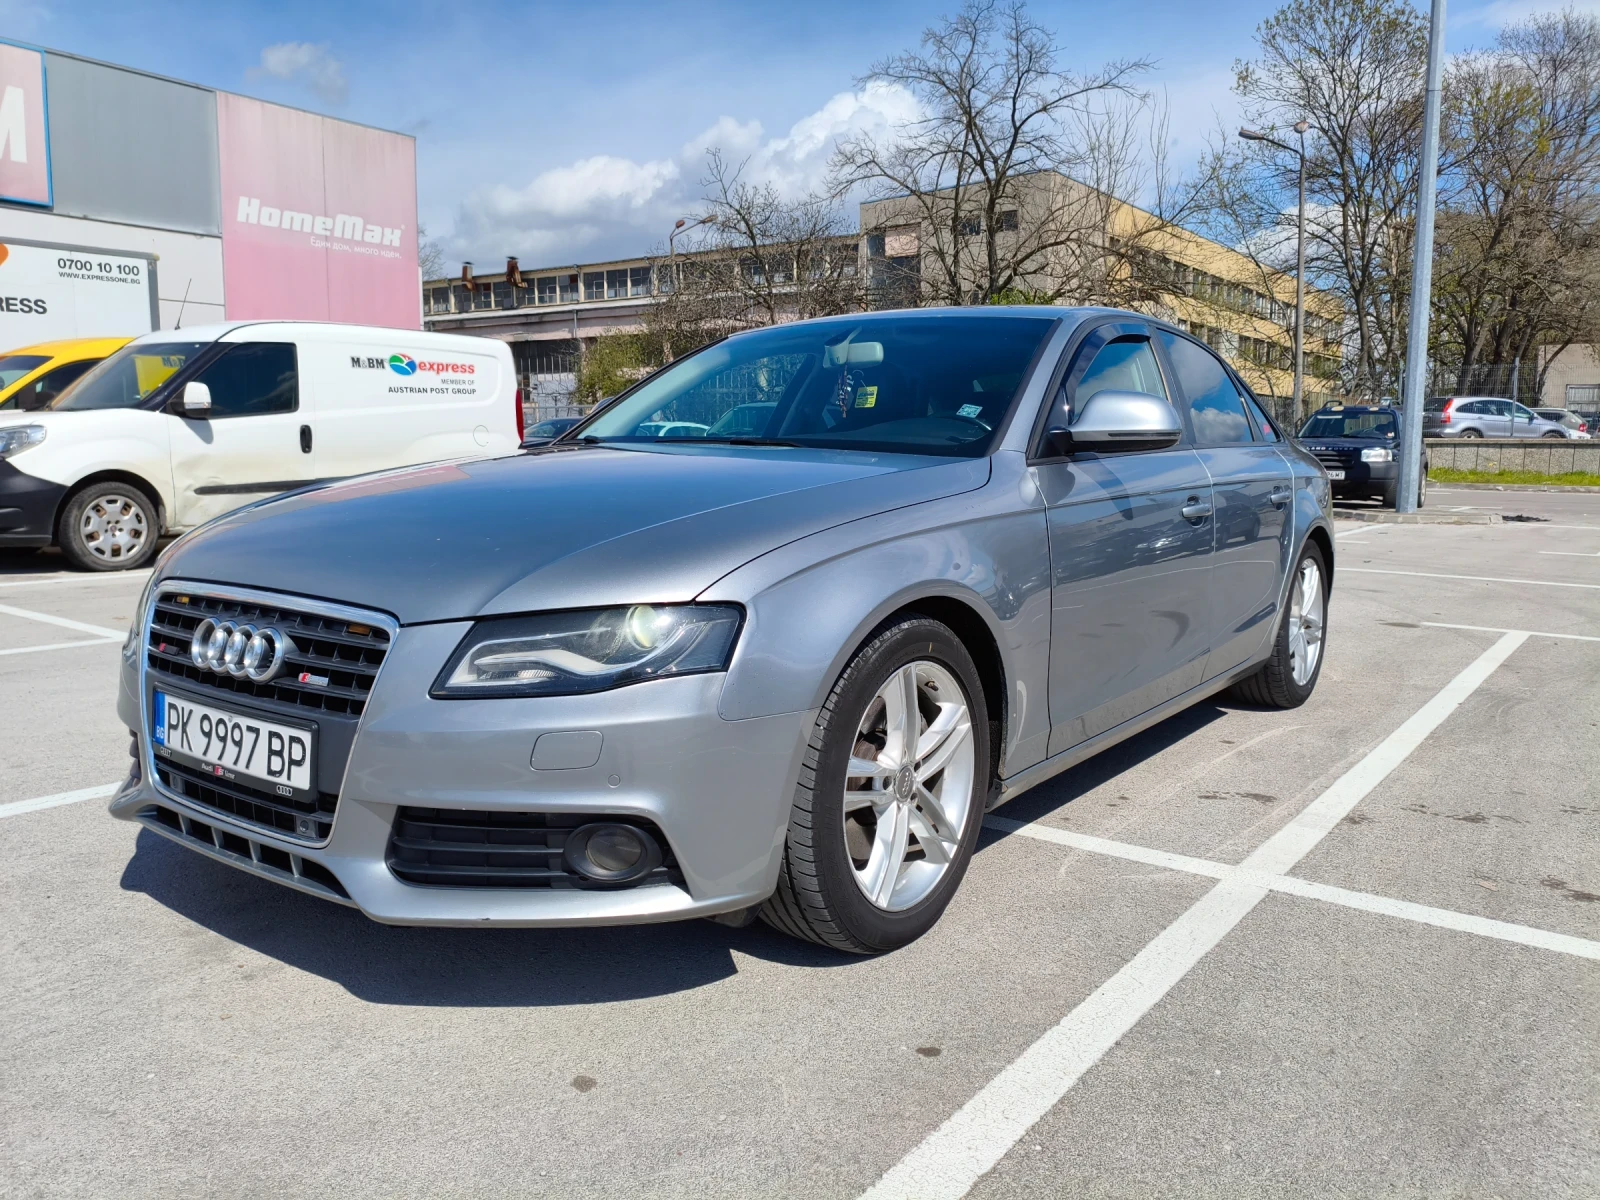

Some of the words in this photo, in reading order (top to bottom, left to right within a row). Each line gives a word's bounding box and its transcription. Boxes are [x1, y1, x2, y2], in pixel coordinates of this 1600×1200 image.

[310, 235, 331, 249] Един
[354, 245, 379, 256] много
[57, 257, 93, 272] 0700
[97, 262, 112, 274] 10
[116, 264, 140, 276] 100
[58, 271, 141, 285] WWW.EXPRESSONE.BG
[350, 356, 386, 370] M&BM
[418, 360, 475, 375] express
[440, 378, 466, 386] MEMBER
[388, 386, 428, 394] AUSTRIAN
[430, 387, 449, 395] POST
[156, 727, 164, 739] BG
[167, 702, 194, 753] PK
[200, 713, 261, 770] 9997
[267, 730, 307, 782] BP
